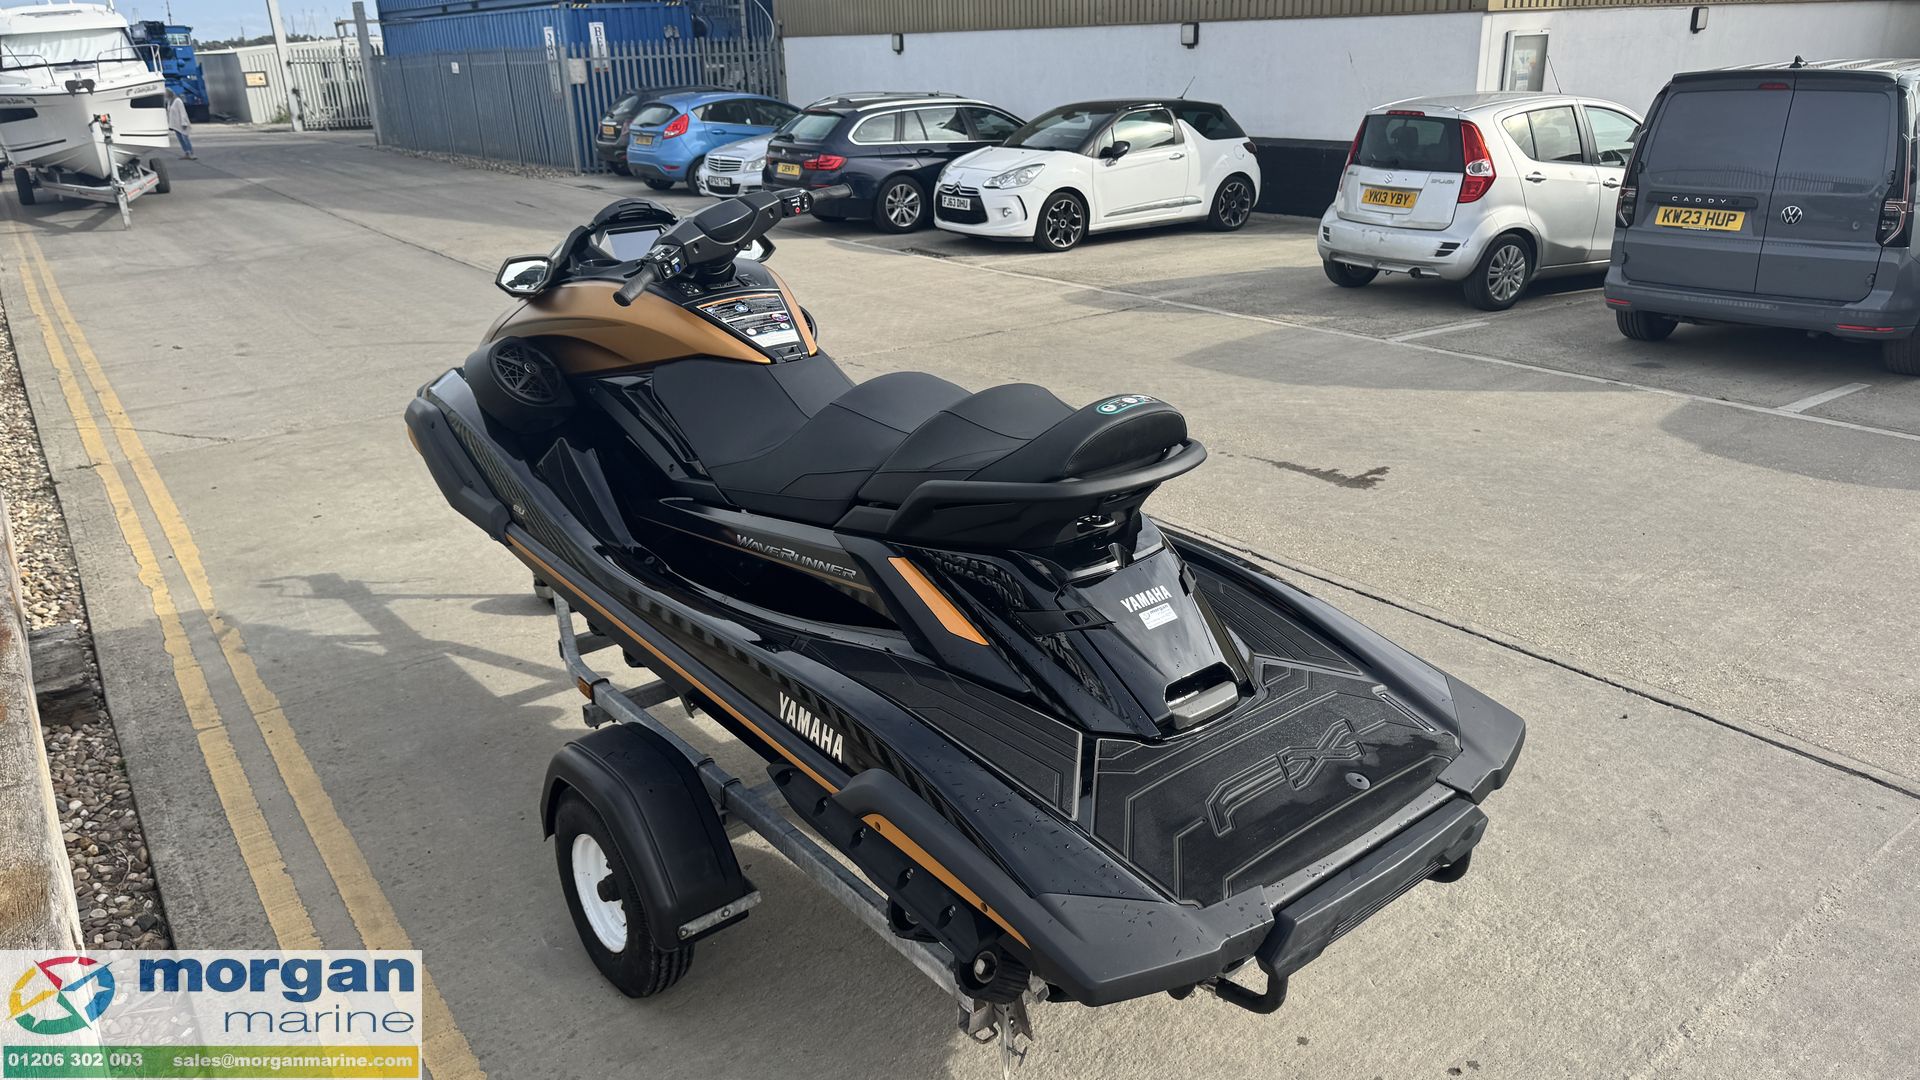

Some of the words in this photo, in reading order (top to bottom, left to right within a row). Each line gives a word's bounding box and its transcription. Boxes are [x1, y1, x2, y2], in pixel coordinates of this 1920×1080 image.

[1368, 188, 1388, 203] YK13
[1390, 191, 1411, 206] YBY
[1671, 195, 1727, 204] CADDY
[1661, 208, 1701, 225] KW23
[1704, 211, 1738, 228] HUP
[1120, 585, 1172, 613] YAMAHA
[780, 691, 843, 764] YAMAHA
